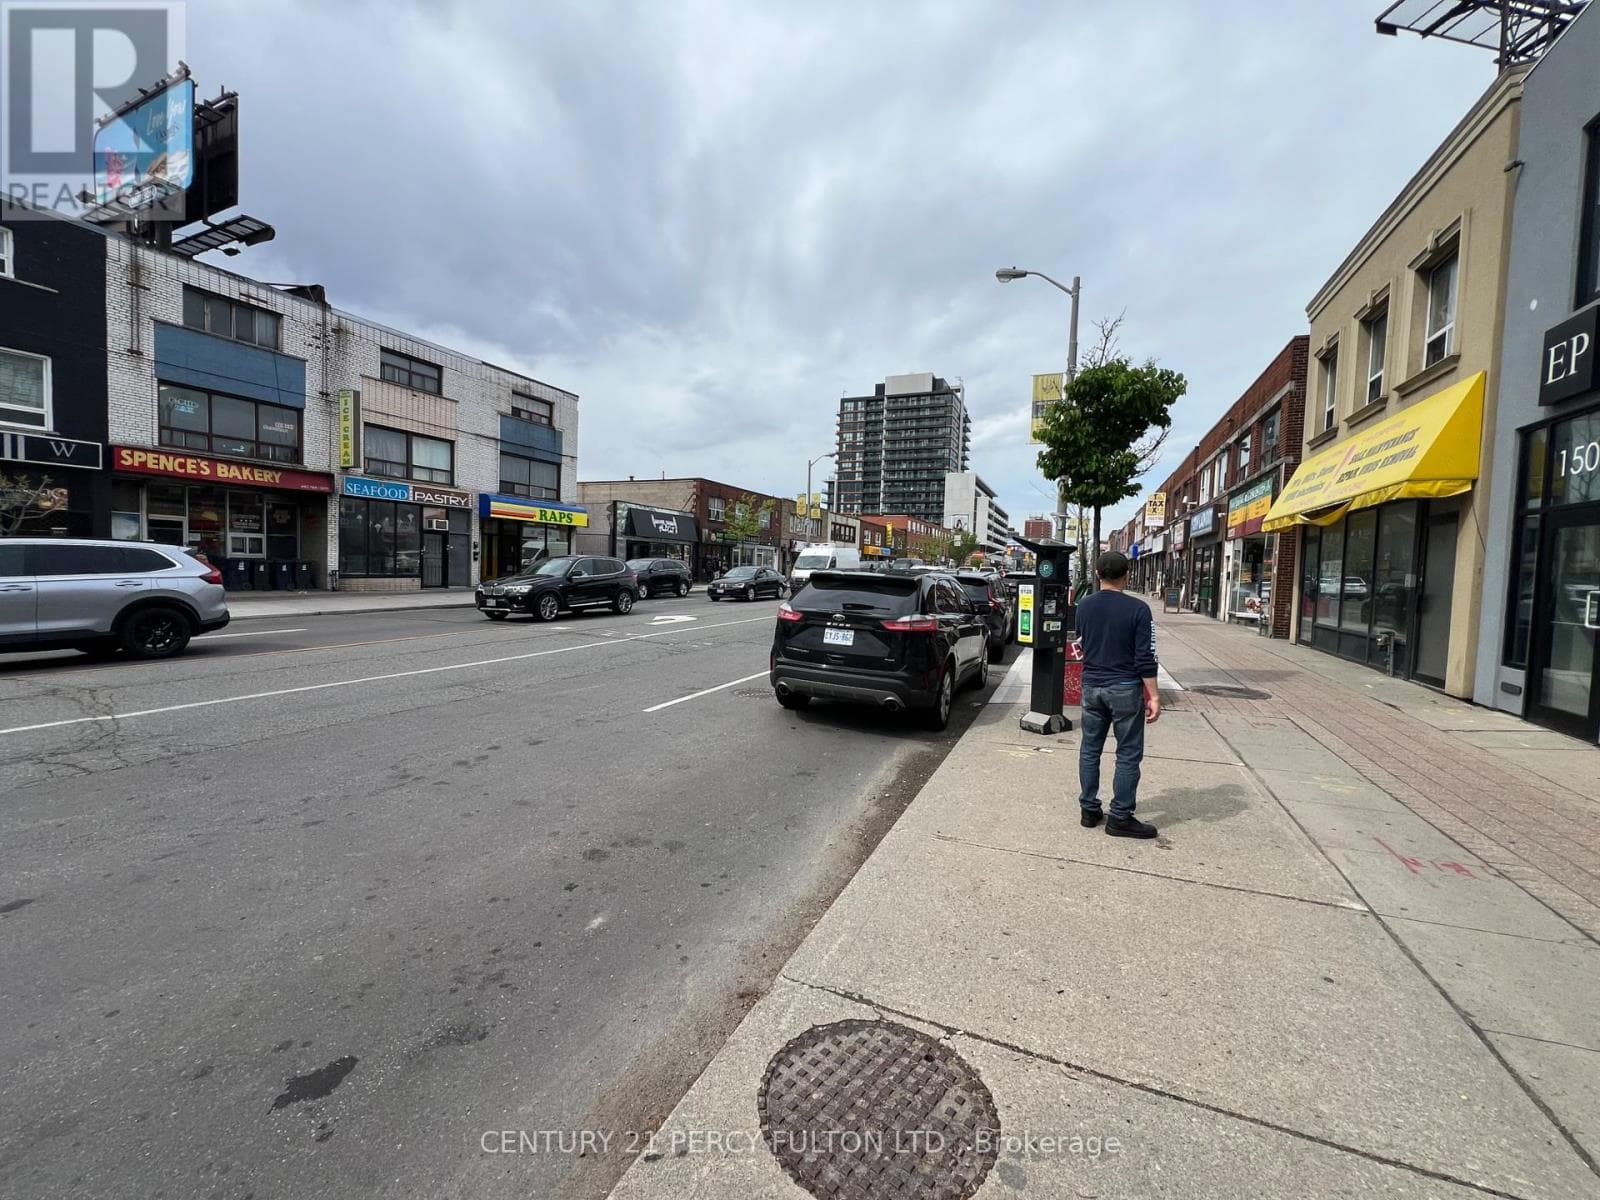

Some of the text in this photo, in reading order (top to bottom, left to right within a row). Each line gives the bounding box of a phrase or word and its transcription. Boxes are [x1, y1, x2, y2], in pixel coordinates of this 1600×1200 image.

[1544, 332, 1590, 385] EP
[50, 441, 75, 458] W
[342, 426, 351, 465] CREAM
[120, 449, 282, 484] SPENCE'S BAKERY
[346, 482, 408, 499] SEAFOOD
[414, 491, 468, 506] PASTRY
[539, 509, 574, 524] RAPS
